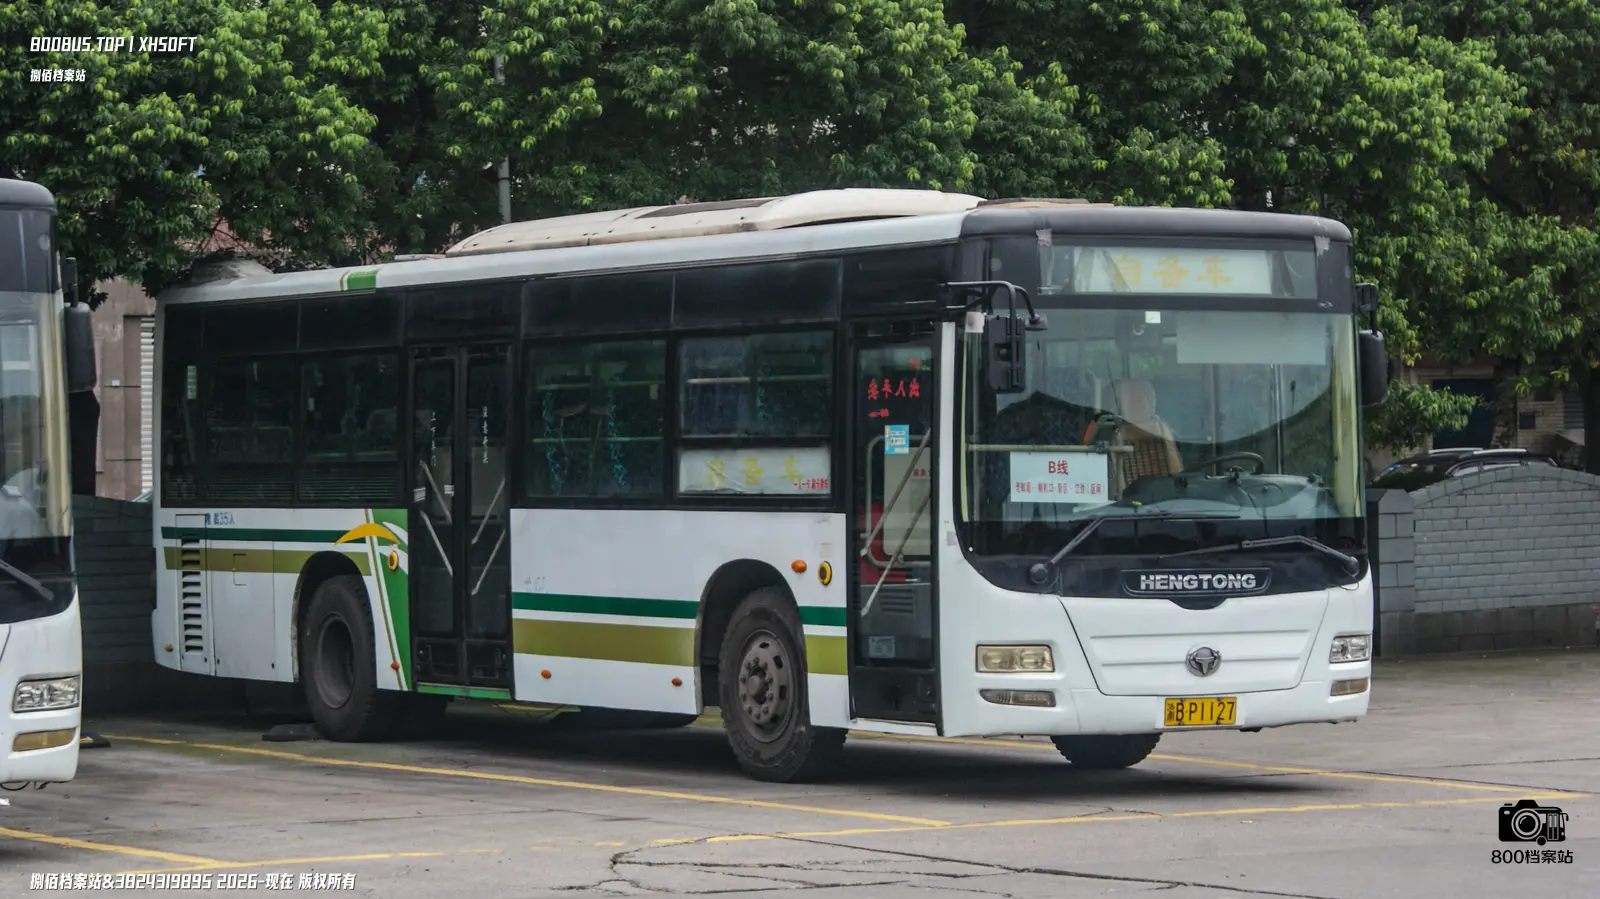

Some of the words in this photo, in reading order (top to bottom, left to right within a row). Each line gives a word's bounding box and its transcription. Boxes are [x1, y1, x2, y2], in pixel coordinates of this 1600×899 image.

[1116, 254, 1234, 289] 自备车
[1048, 460, 1069, 475] B线
[1140, 574, 1257, 590] HENGTONG
